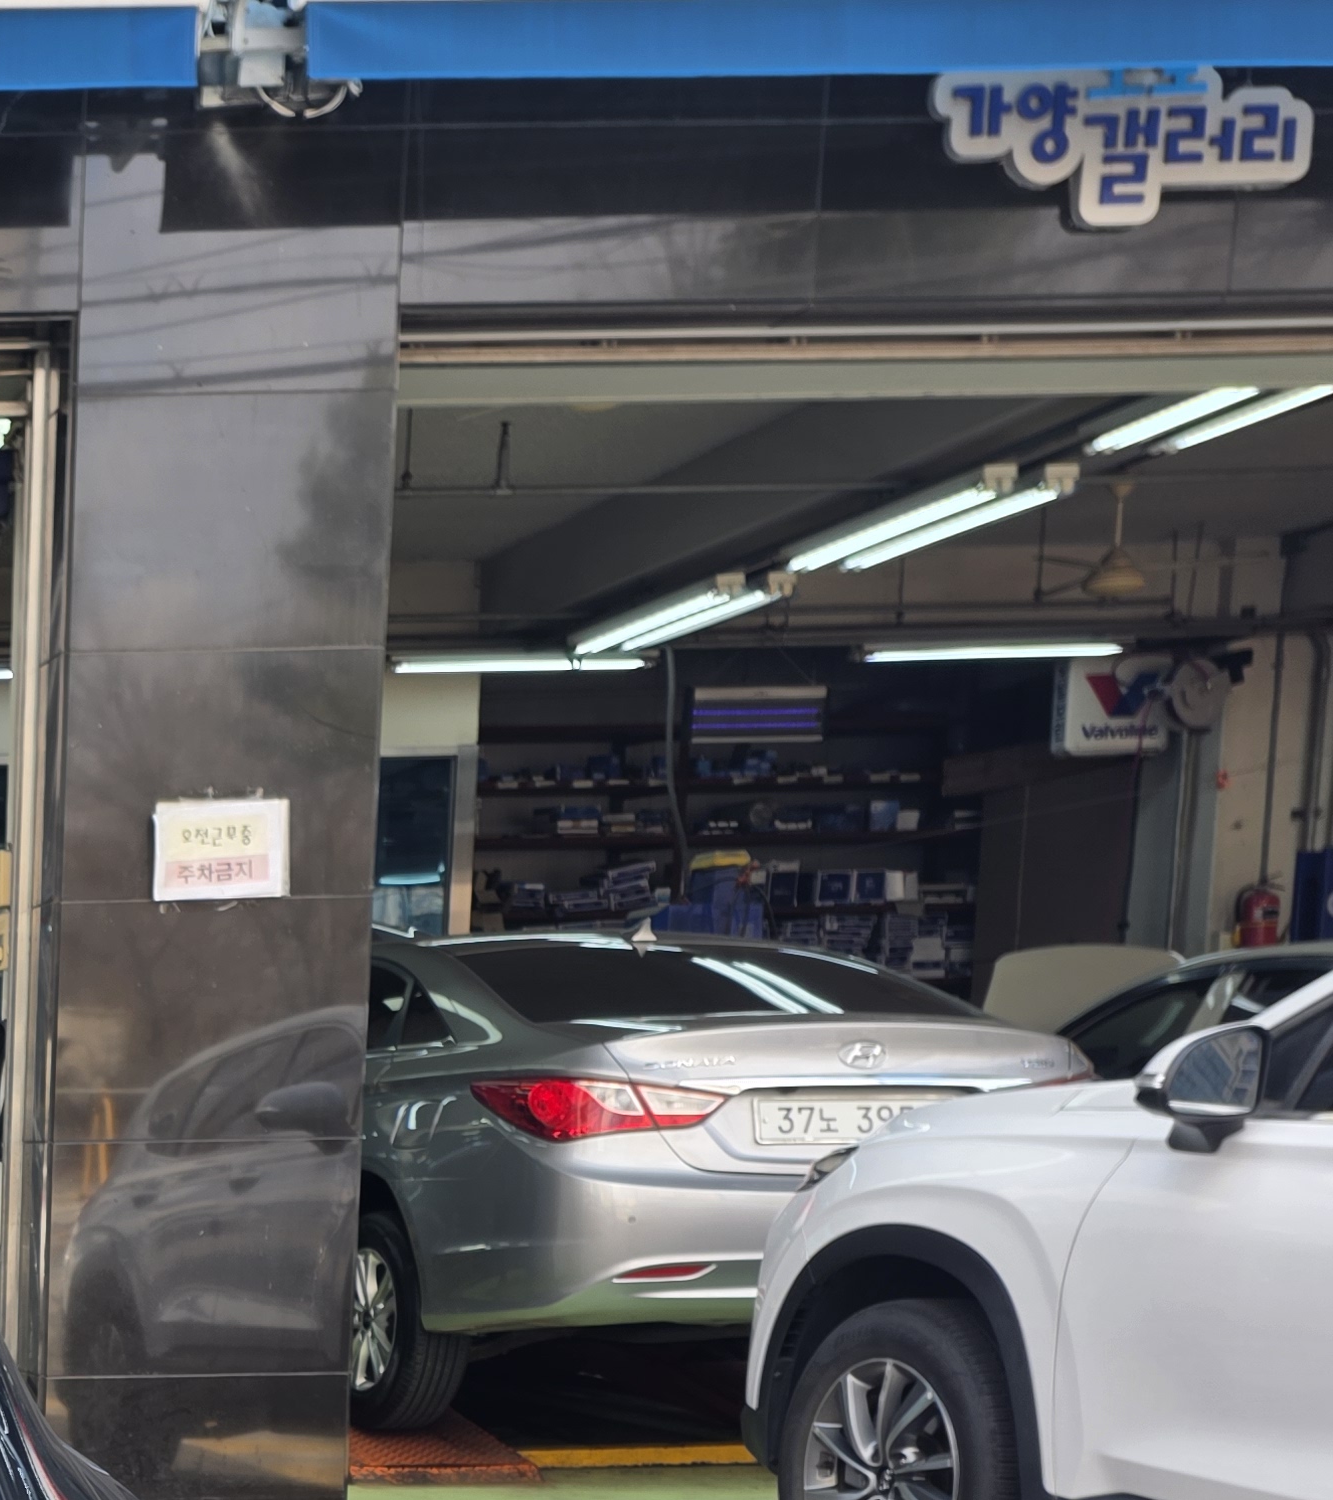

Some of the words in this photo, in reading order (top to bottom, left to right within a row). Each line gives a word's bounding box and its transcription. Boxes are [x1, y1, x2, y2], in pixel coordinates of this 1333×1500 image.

[952, 82, 1078, 163] 가양
[1084, 104, 1297, 204] 갤러리
[177, 859, 253, 884] 주차금지
[777, 1105, 839, 1134] 37노
[856, 1105, 915, 1135] 39
